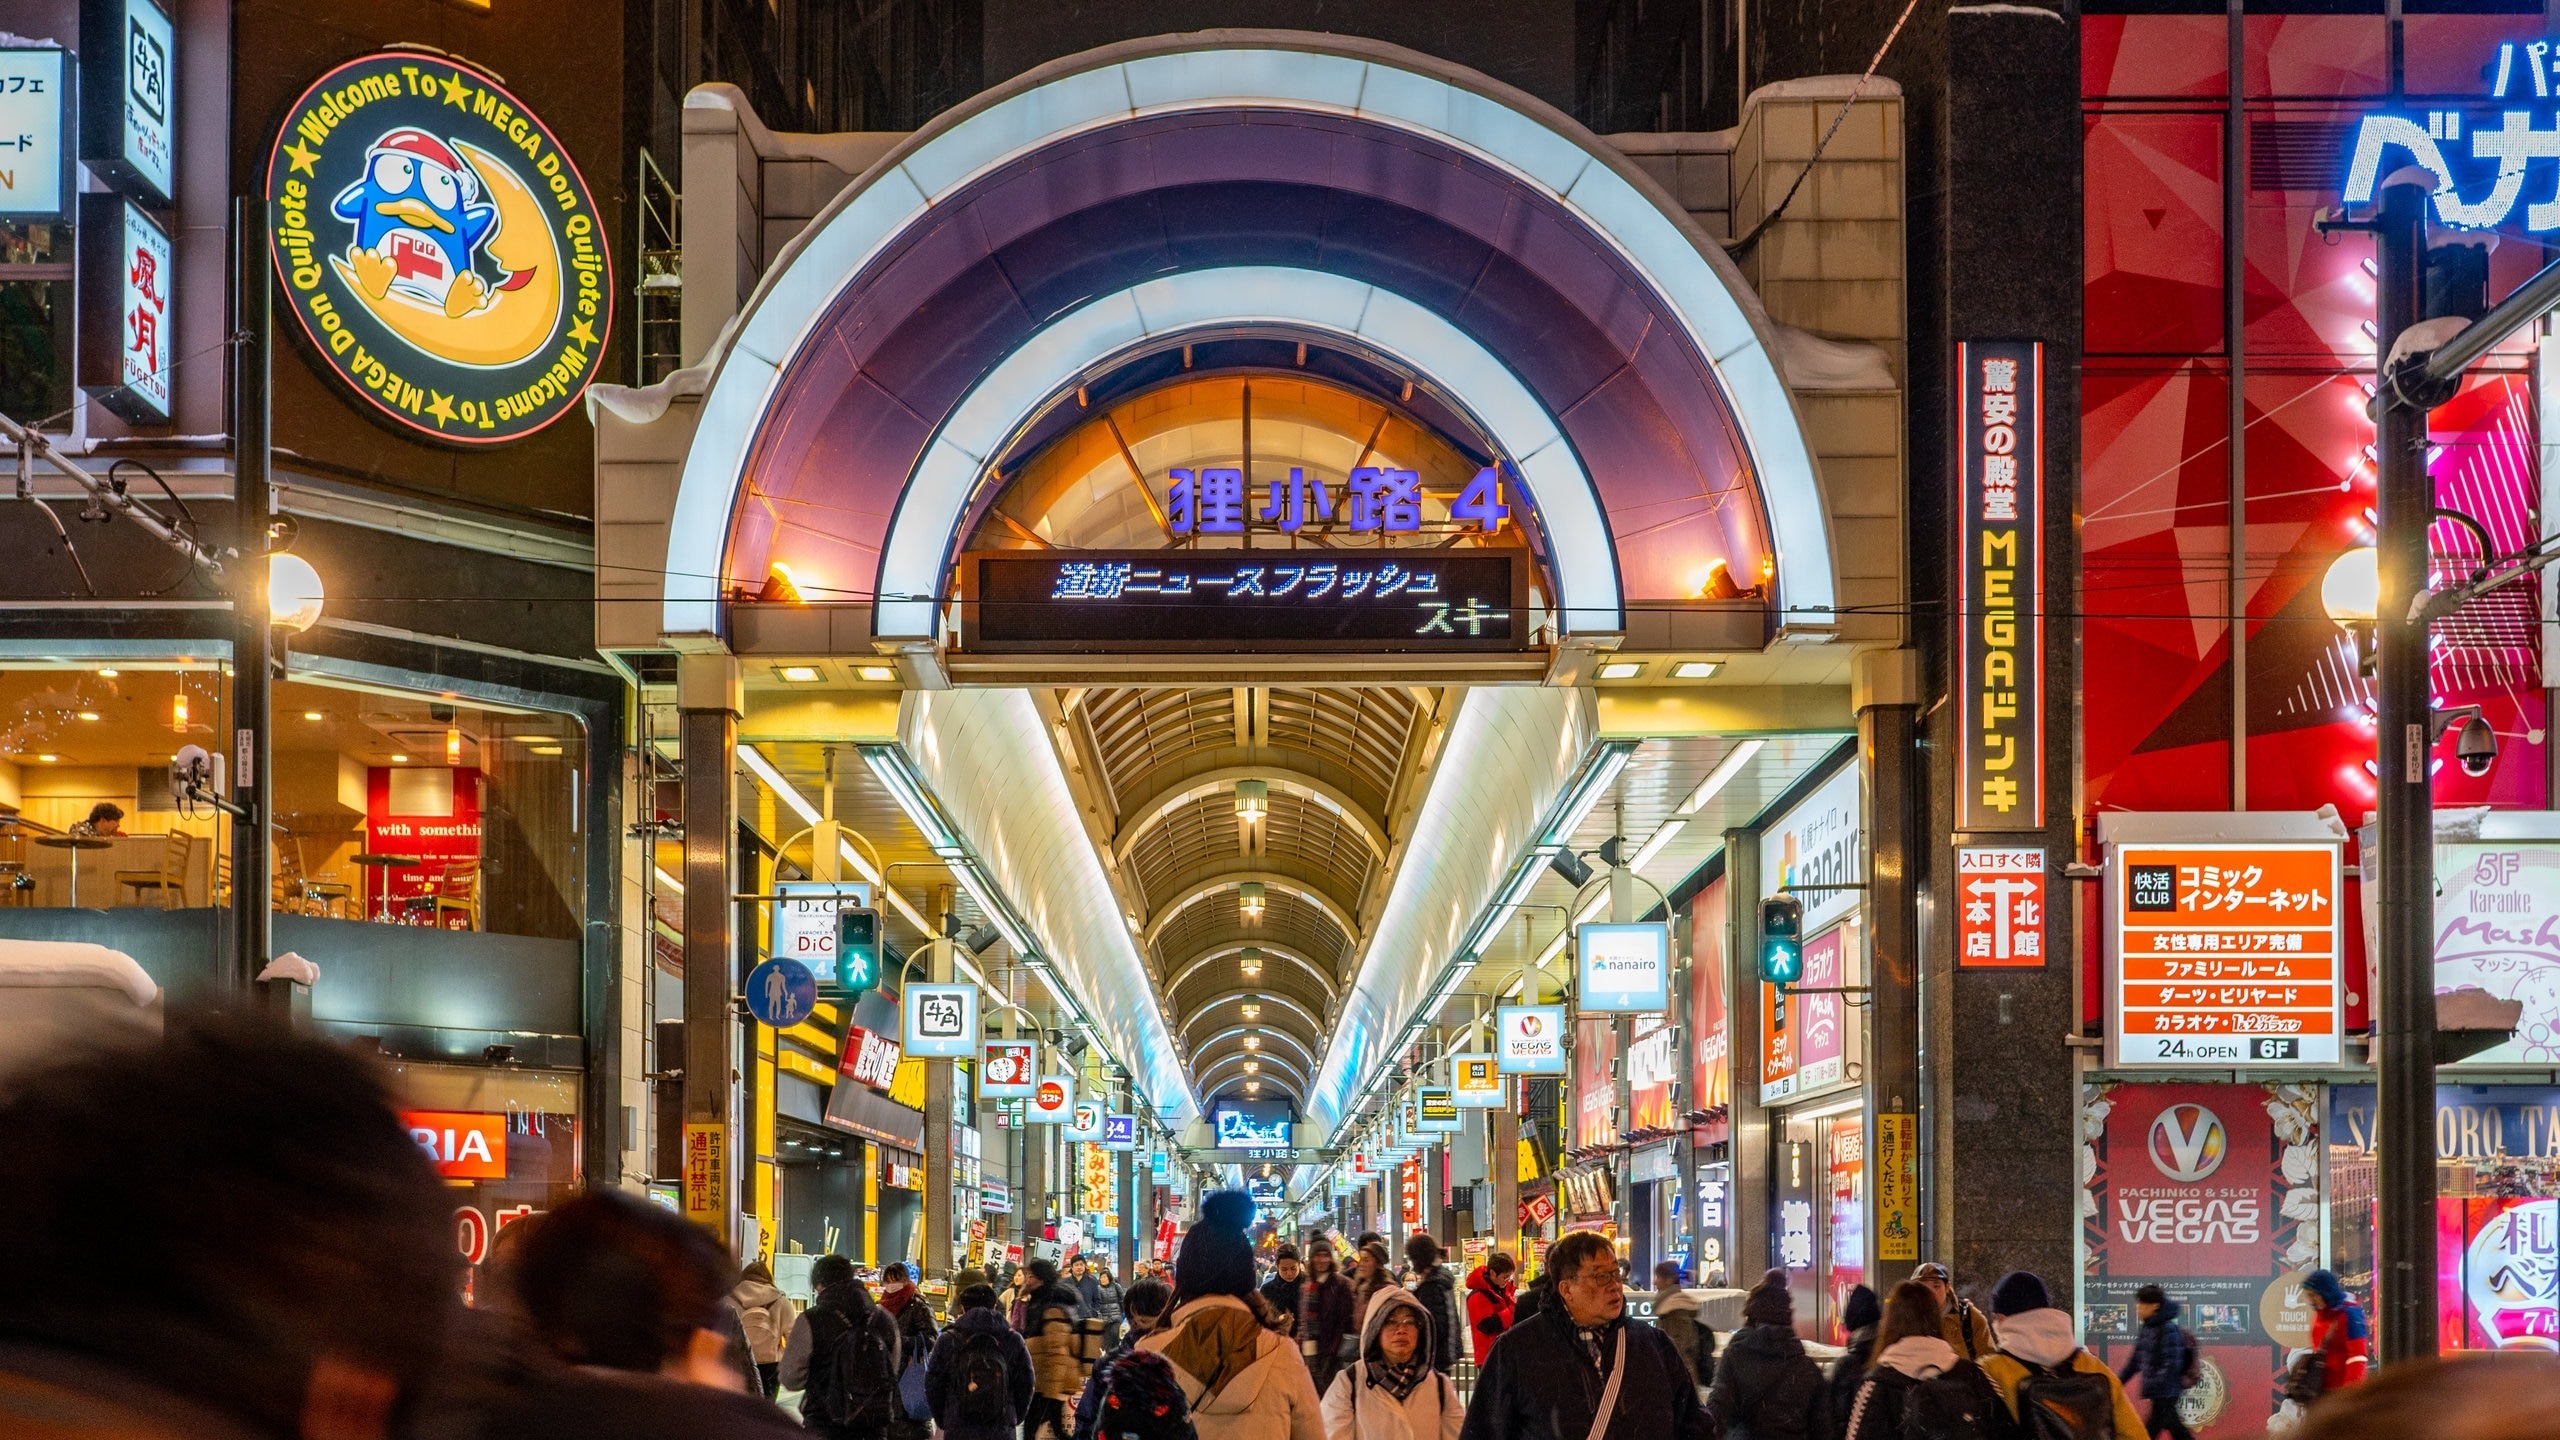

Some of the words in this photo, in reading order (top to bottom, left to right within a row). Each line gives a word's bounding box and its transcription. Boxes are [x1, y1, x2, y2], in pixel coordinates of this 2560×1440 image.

[2494, 41, 2560, 96] パ
[0, 76, 44, 93] フェ
[297, 72, 402, 146] Welcome
[401, 66, 437, 98] To
[473, 88, 542, 160] MEGA
[537, 152, 578, 212] Don
[565, 213, 603, 316] Quijote
[278, 179, 323, 291] Quijote
[127, 245, 166, 374] 風月
[309, 293, 356, 356] Don
[350, 345, 424, 415] MEGA
[495, 345, 588, 421] Welcome
[461, 401, 495, 429] To
[1981, 358, 2018, 521] 驚安の殿堂
[1168, 466, 1421, 536] 狸小路
[1449, 466, 1511, 536] 4
[1052, 563, 1439, 599] 道新ニュースフラッシュ
[1415, 597, 1509, 636] スキー
[1982, 529, 2018, 813] MEGAドンキ
[377, 823, 411, 836] with
[1962, 853, 2041, 869] 入口すぐ隣
[2474, 853, 2520, 886] 5F
[402, 873, 424, 882] time
[2134, 872, 2169, 891] 快活
[2180, 865, 2263, 888] コミック
[2135, 892, 2170, 905] CLUB
[2180, 889, 2328, 912] インターネット
[2470, 889, 2531, 914] Karaoke
[1965, 900, 1992, 958] 本店
[2013, 900, 2040, 958] 北館
[798, 936, 833, 951] DiC
[2153, 934, 2303, 951] 女性専用エリア完備
[814, 961, 827, 976] 4
[1609, 958, 1656, 970] nanairo
[1806, 947, 1834, 985] カラオケ
[2163, 961, 2291, 977] ファミリールーム
[2472, 957, 2531, 973] マッシュ
[1617, 993, 1629, 1006] 4
[2159, 987, 2298, 1005] ダーツ・ビリヤード
[925, 1002, 958, 1027] 牛角
[935, 1042, 945, 1052] 4
[2197, 1047, 2238, 1058] OPEN
[2259, 1040, 2289, 1058] 6F
[1291, 1149, 1300, 1158] 5
[1882, 1119, 1896, 1209] ご通行ください
[1900, 1118, 1913, 1208] 自転車から降りて
[690, 1131, 708, 1212] 通行禁止
[709, 1131, 721, 1211] 許可車両以外
[2119, 1188, 2199, 1198] PACHINKO
[2204, 1188, 2216, 1198] &
[2219, 1188, 2259, 1198] SLOT
[2118, 1199, 2259, 1222] VEGAS
[2118, 1221, 2259, 1244] VEGAS
[2280, 1311, 2307, 1322] TOUCH
